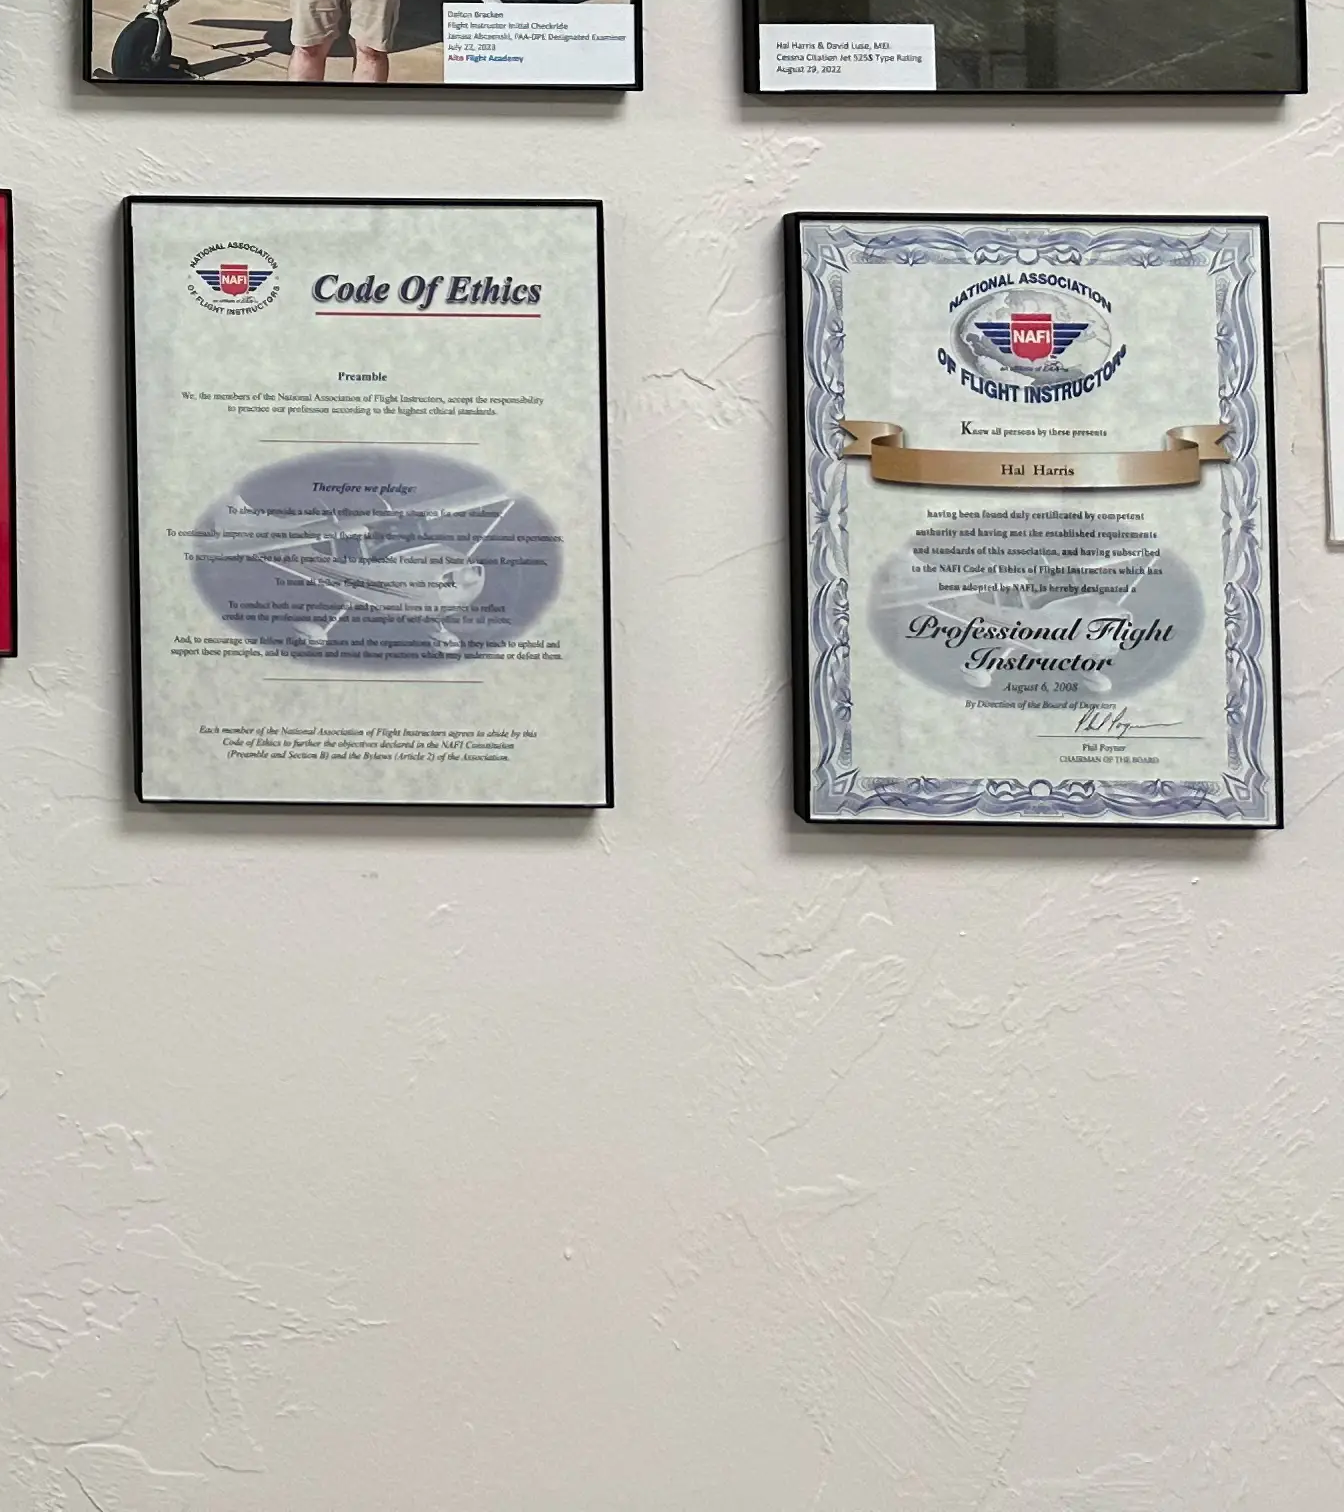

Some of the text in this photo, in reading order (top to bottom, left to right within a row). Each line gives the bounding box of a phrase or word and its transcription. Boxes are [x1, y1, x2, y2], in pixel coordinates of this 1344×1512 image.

[190, 242, 278, 269] NATIONAL ASSOCIATION
[312, 274, 542, 310] Code Of Ethics
[949, 273, 1112, 313] NATIONAL ASSOCIATION
[196, 296, 225, 314] FLIGHT
[227, 286, 280, 315] INSTRUCTORS
[1013, 330, 1050, 344] NAFI
[337, 372, 388, 382] Preamble
[937, 344, 1127, 403] OF FLIGHT INSTRUCTORS
[375, 395, 397, 404] Flight
[1004, 429, 1035, 437] persons
[1072, 429, 1107, 438] presents
[1002, 465, 1075, 476] Hal Harris
[312, 483, 361, 495] Therefore
[927, 510, 957, 520] having
[1010, 510, 1030, 520] duly
[1032, 511, 1082, 520] certificated
[1098, 513, 1144, 521] competent
[916, 528, 956, 537] authority
[978, 529, 1007, 538] having
[1098, 531, 1157, 539] requirements
[1080, 548, 1110, 558] having
[1113, 548, 1160, 557] subscribed
[999, 565, 1025, 573] Ethics
[1040, 566, 1064, 576] Flight
[1067, 566, 1116, 574] Instructors
[962, 583, 997, 592] adopted
[1049, 585, 1077, 594] hereby
[1081, 585, 1128, 594] designated
[906, 615, 1176, 650] Professional Flight
[965, 647, 1113, 672] Instructor
[1003, 682, 1039, 693] August
[1054, 682, 1079, 692] 2008
